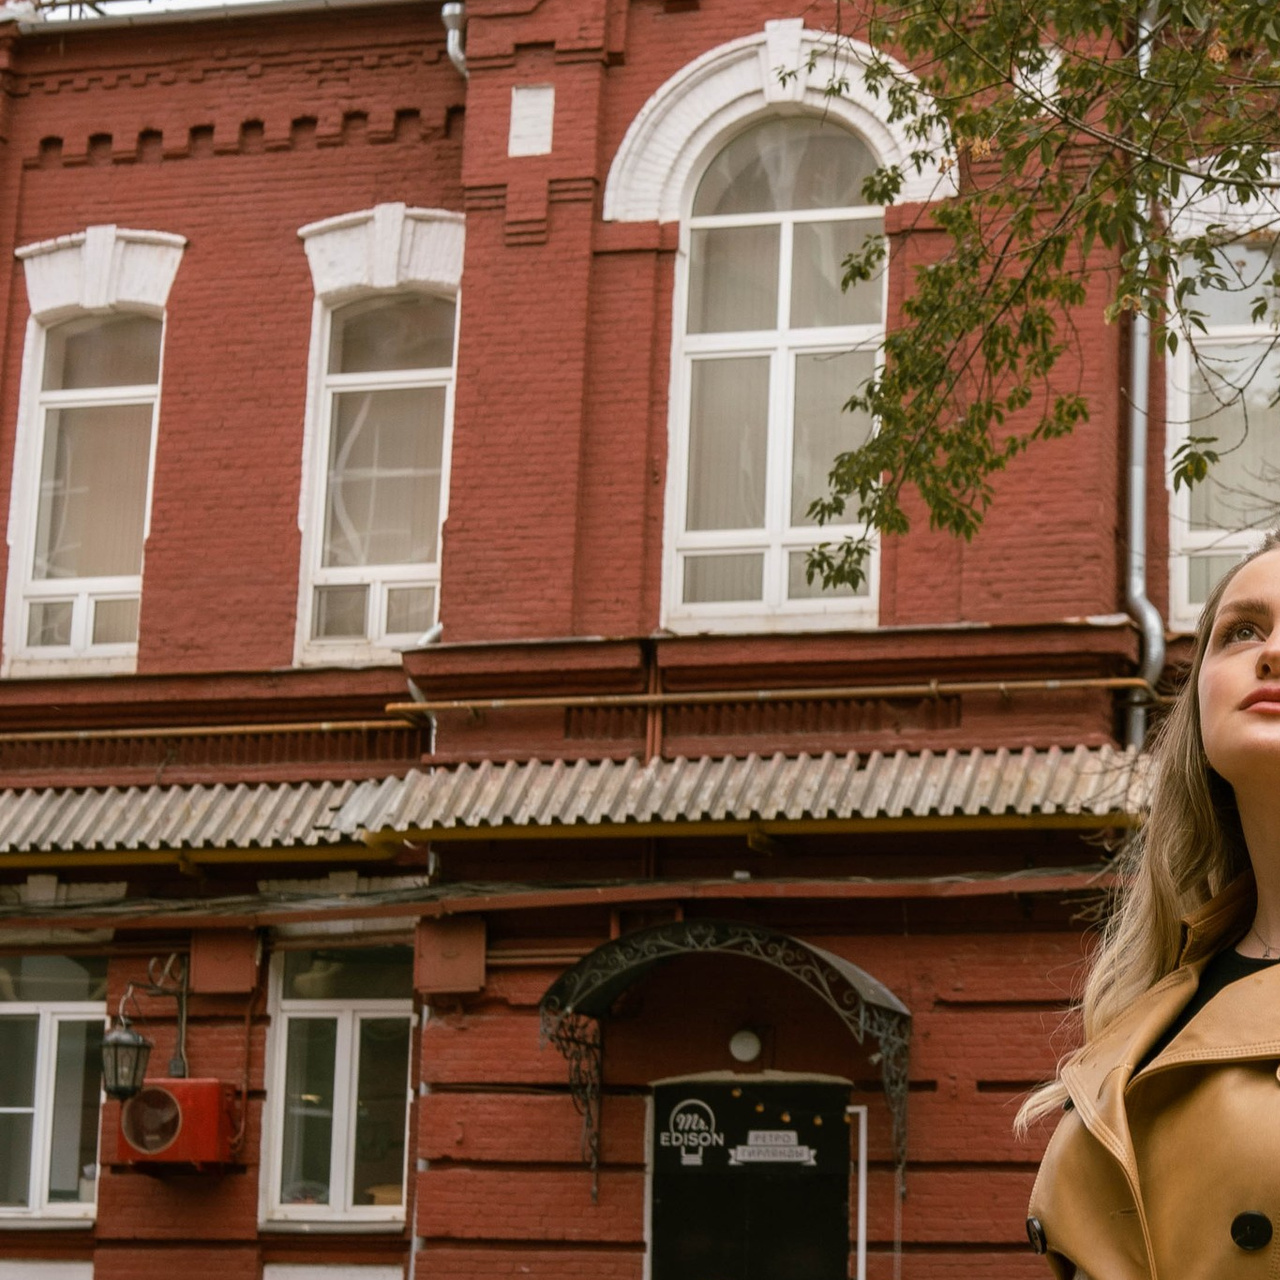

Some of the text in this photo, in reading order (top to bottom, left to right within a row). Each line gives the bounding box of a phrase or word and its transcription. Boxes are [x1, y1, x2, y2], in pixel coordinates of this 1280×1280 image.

[675, 1113, 709, 1131] Mr.
[660, 1132, 724, 1146] EDISON
[753, 1133, 792, 1143] РЕТРО
